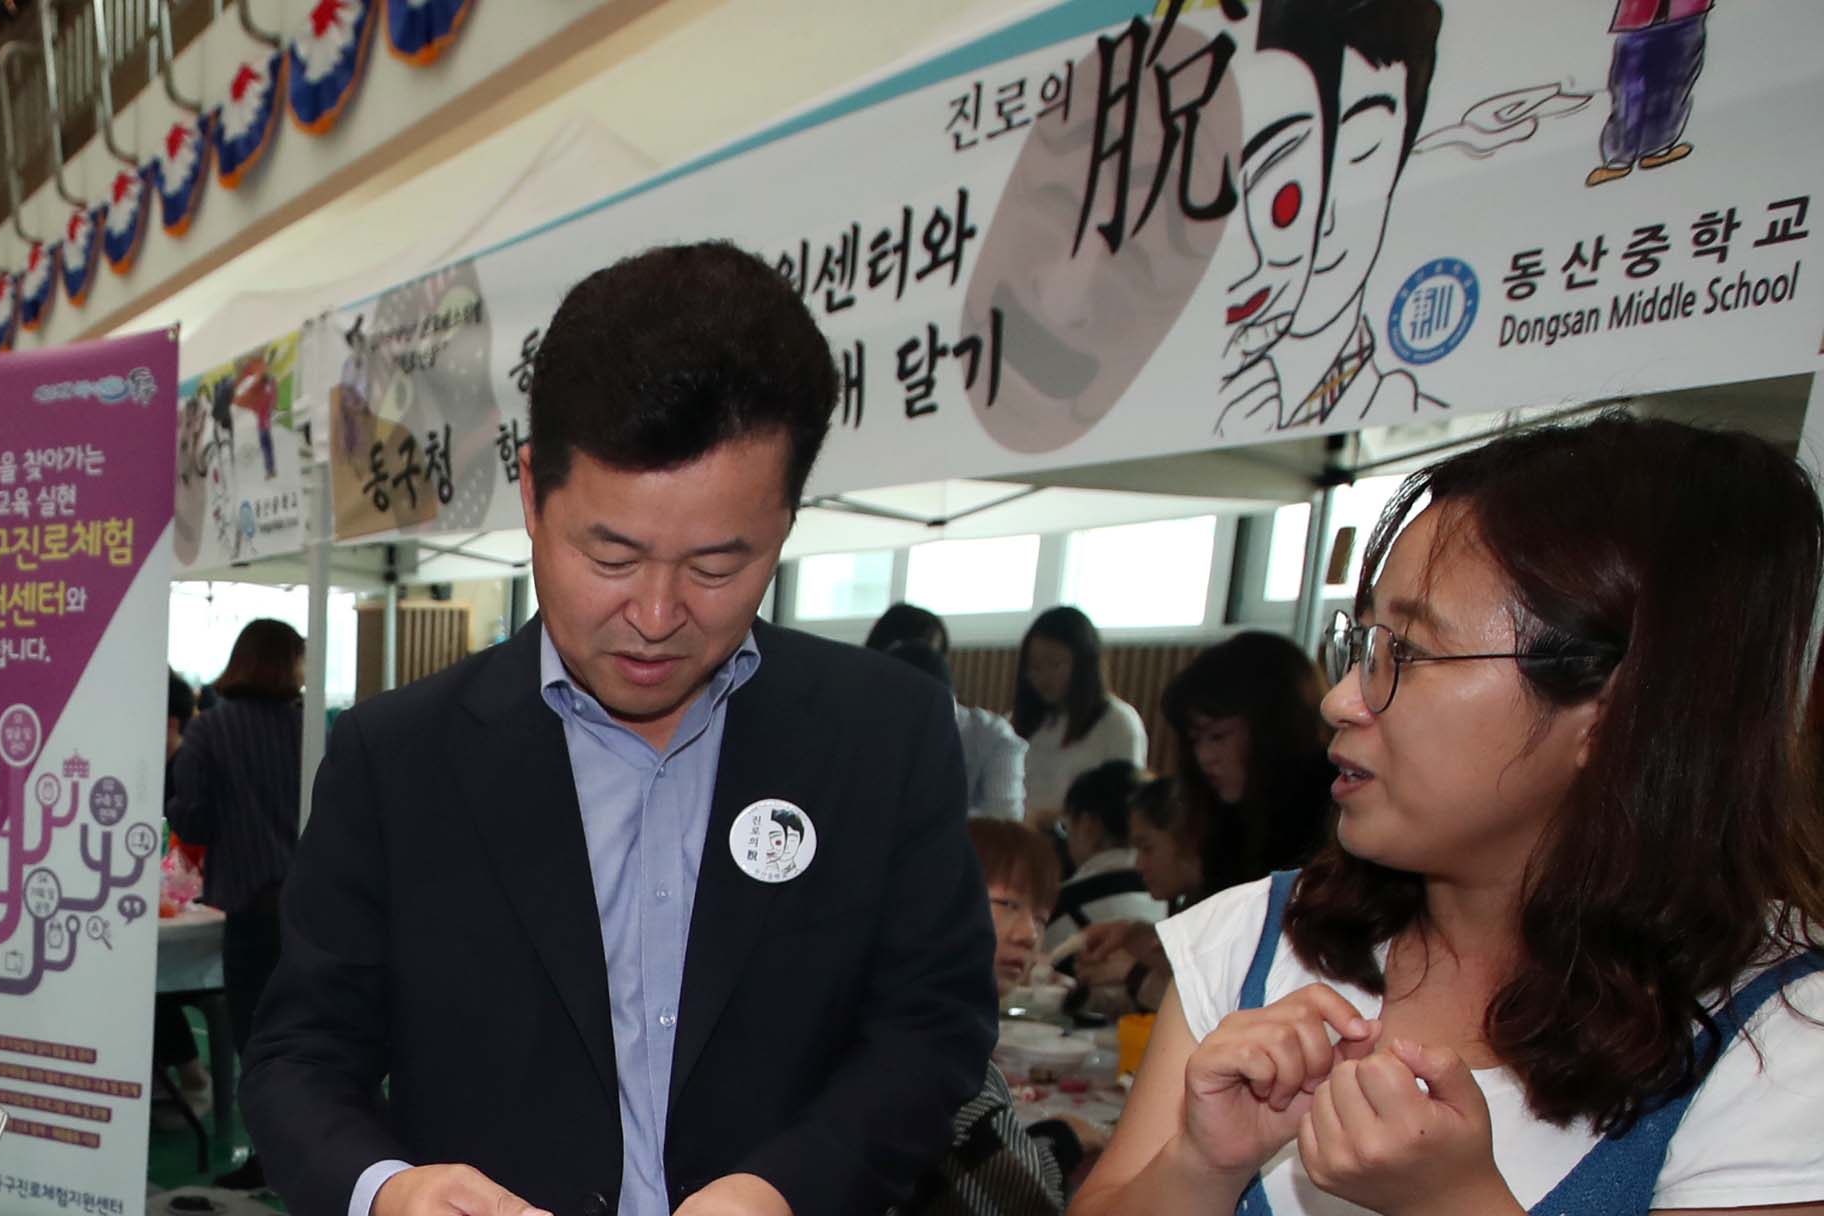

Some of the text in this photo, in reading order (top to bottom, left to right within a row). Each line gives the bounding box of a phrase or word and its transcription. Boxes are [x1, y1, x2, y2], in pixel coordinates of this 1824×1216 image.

[946, 59, 1074, 152] 진로의
[1498, 304, 1599, 348] Dongsan
[1609, 281, 1697, 330] Middle
[1703, 260, 1802, 315] School
[896, 306, 1003, 418] 달기
[23, 444, 105, 481] 찾아가는
[38, 484, 76, 517] 실현
[363, 422, 454, 512] 동구청
